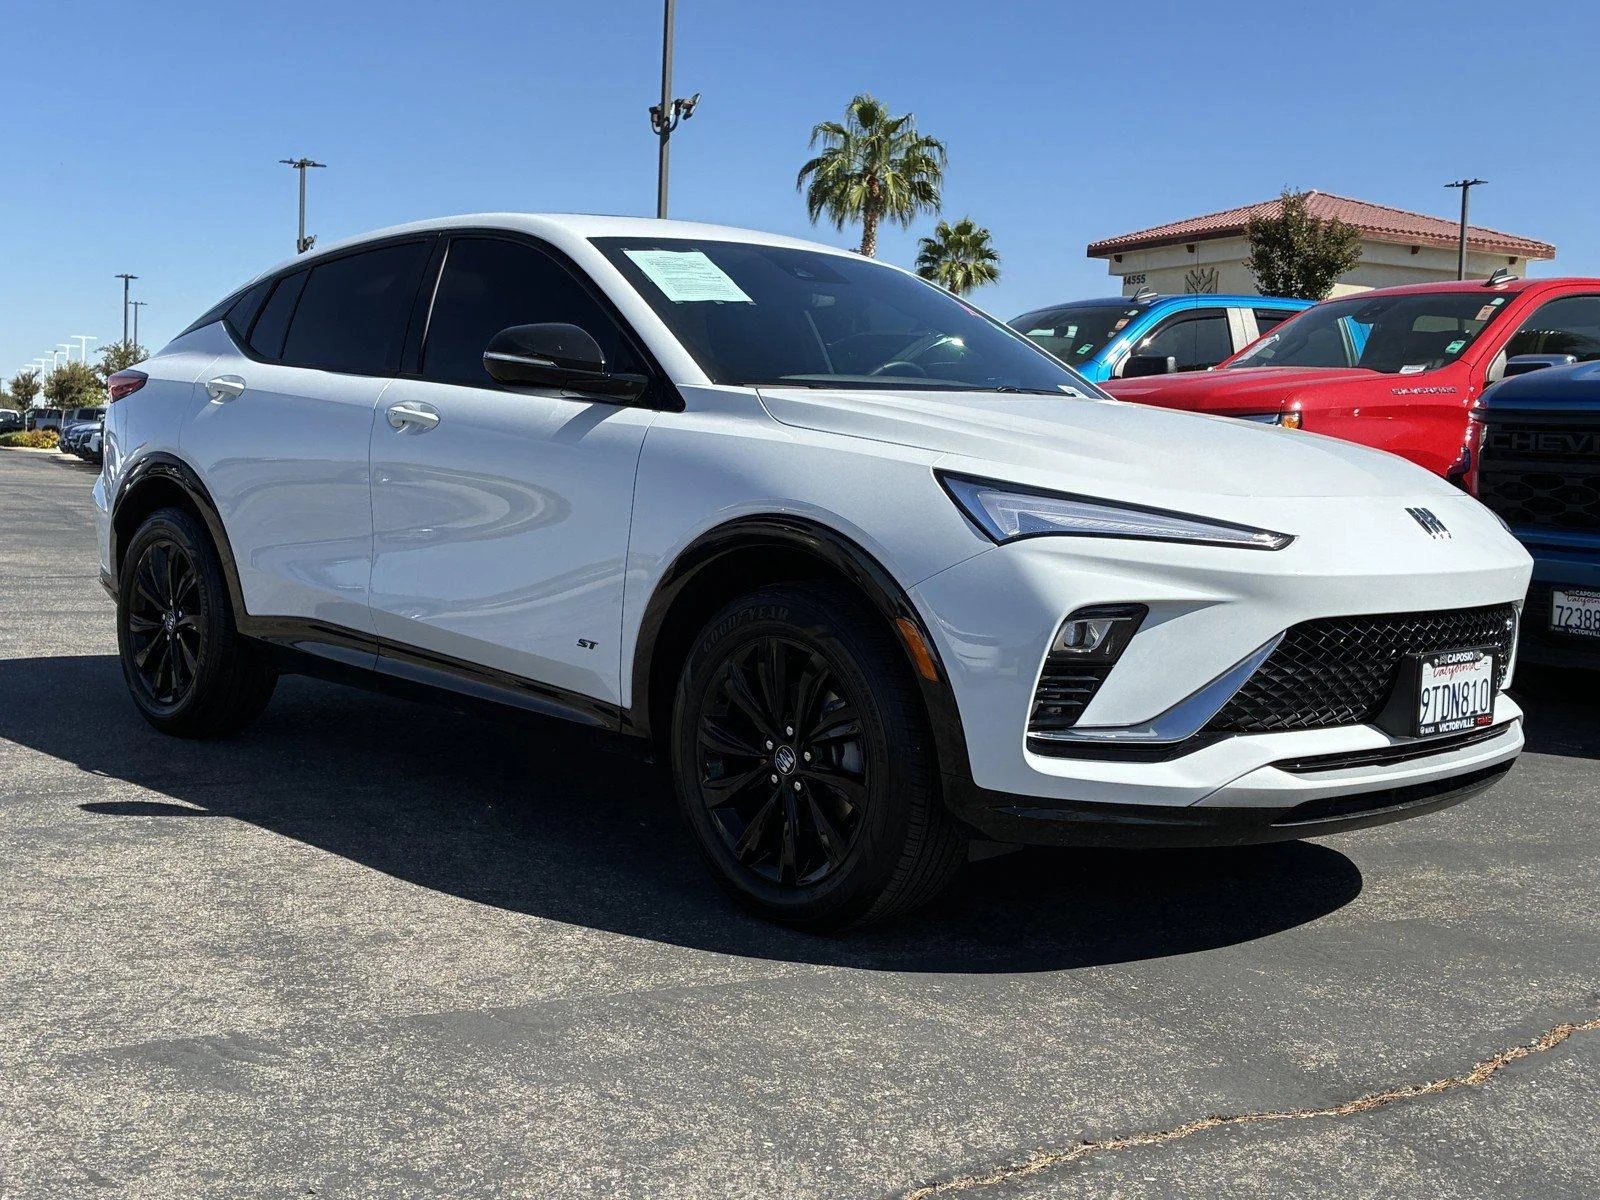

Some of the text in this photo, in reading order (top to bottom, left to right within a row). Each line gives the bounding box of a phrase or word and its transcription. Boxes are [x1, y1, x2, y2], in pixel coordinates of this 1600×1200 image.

[577, 638, 599, 650] ST
[1447, 651, 1474, 663] CAPOSIO
[1432, 662, 1481, 680] California
[1420, 678, 1489, 724] 9TDN810
[1438, 718, 1475, 733] VICTORVILLE
